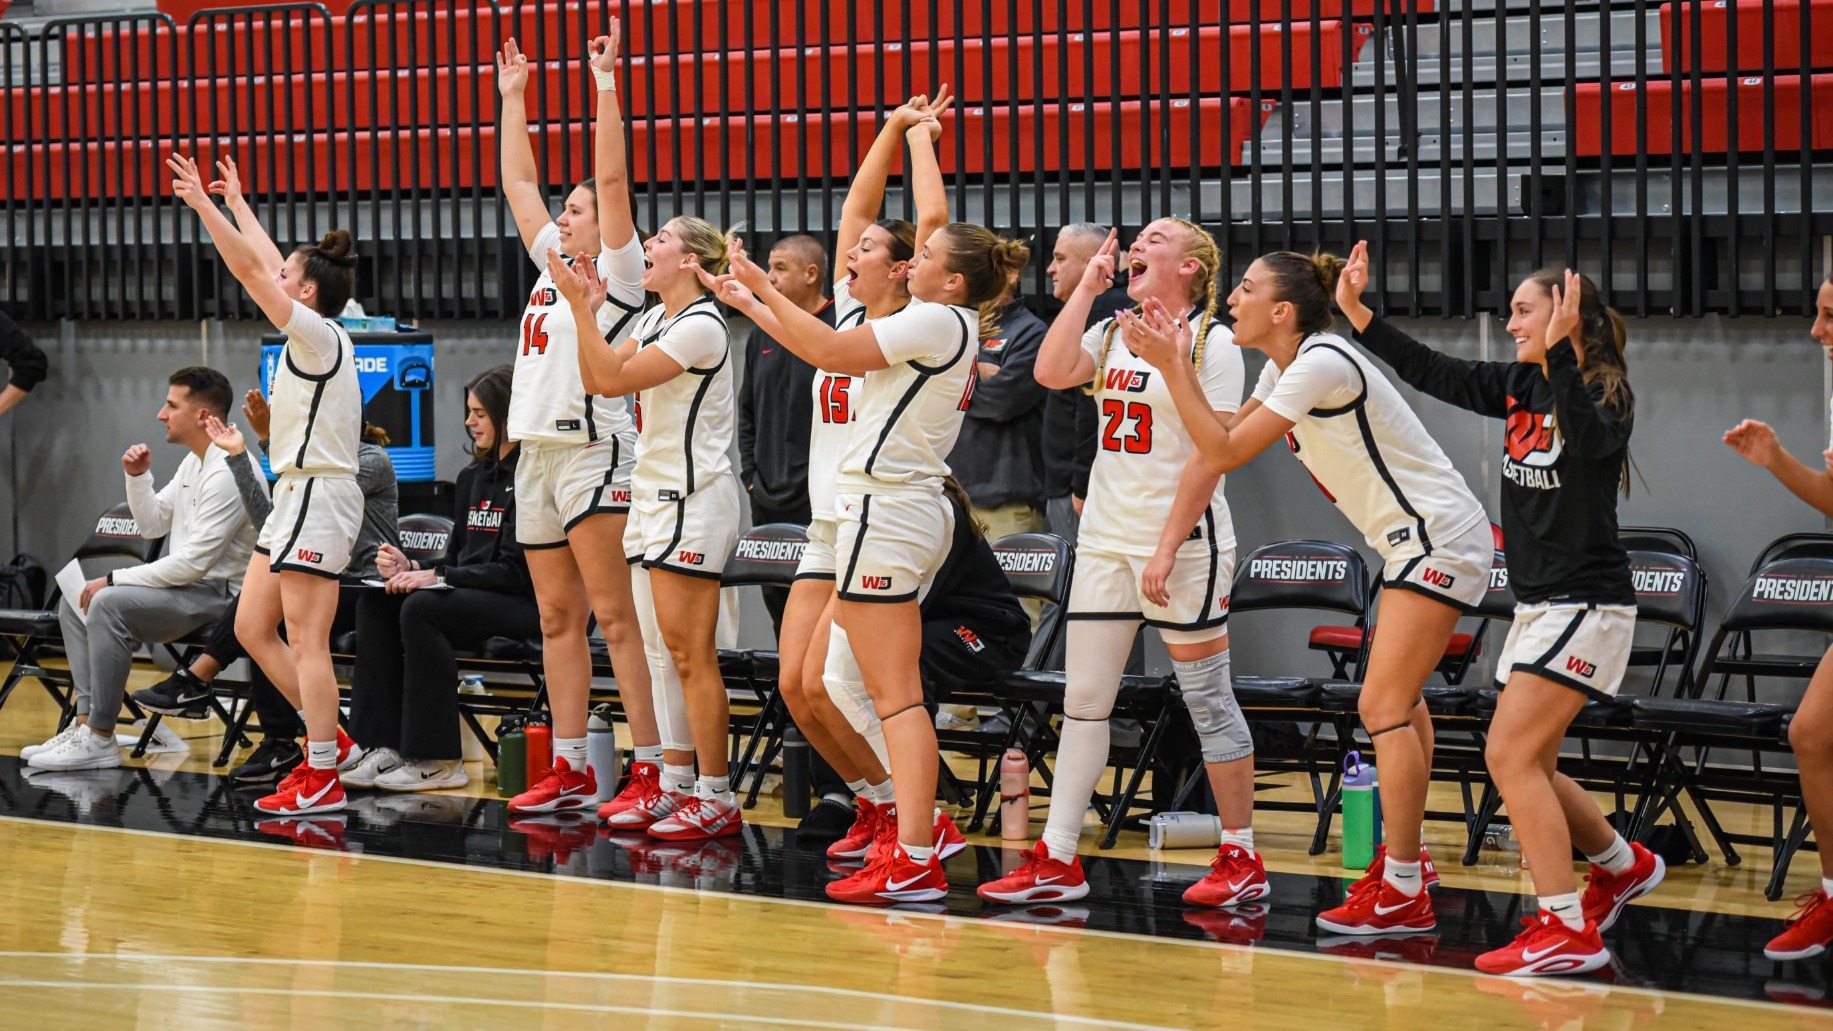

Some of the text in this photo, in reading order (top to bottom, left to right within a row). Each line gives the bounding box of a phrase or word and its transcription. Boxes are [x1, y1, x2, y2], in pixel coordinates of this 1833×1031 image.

[530, 287, 557, 306] W&J
[523, 313, 549, 356] 14
[1105, 368, 1151, 393] W&J
[819, 376, 852, 424] 15
[1102, 398, 1153, 454] 23
[678, 550, 705, 565] W&J
[735, 540, 808, 561] PRESIDENTS
[1250, 559, 1347, 580] PRESIDENTS
[1422, 567, 1455, 589] W&J
[862, 575, 892, 590] W&J
[1753, 578, 1833, 601] PRESIDEN
[1565, 655, 1597, 679] W&J
